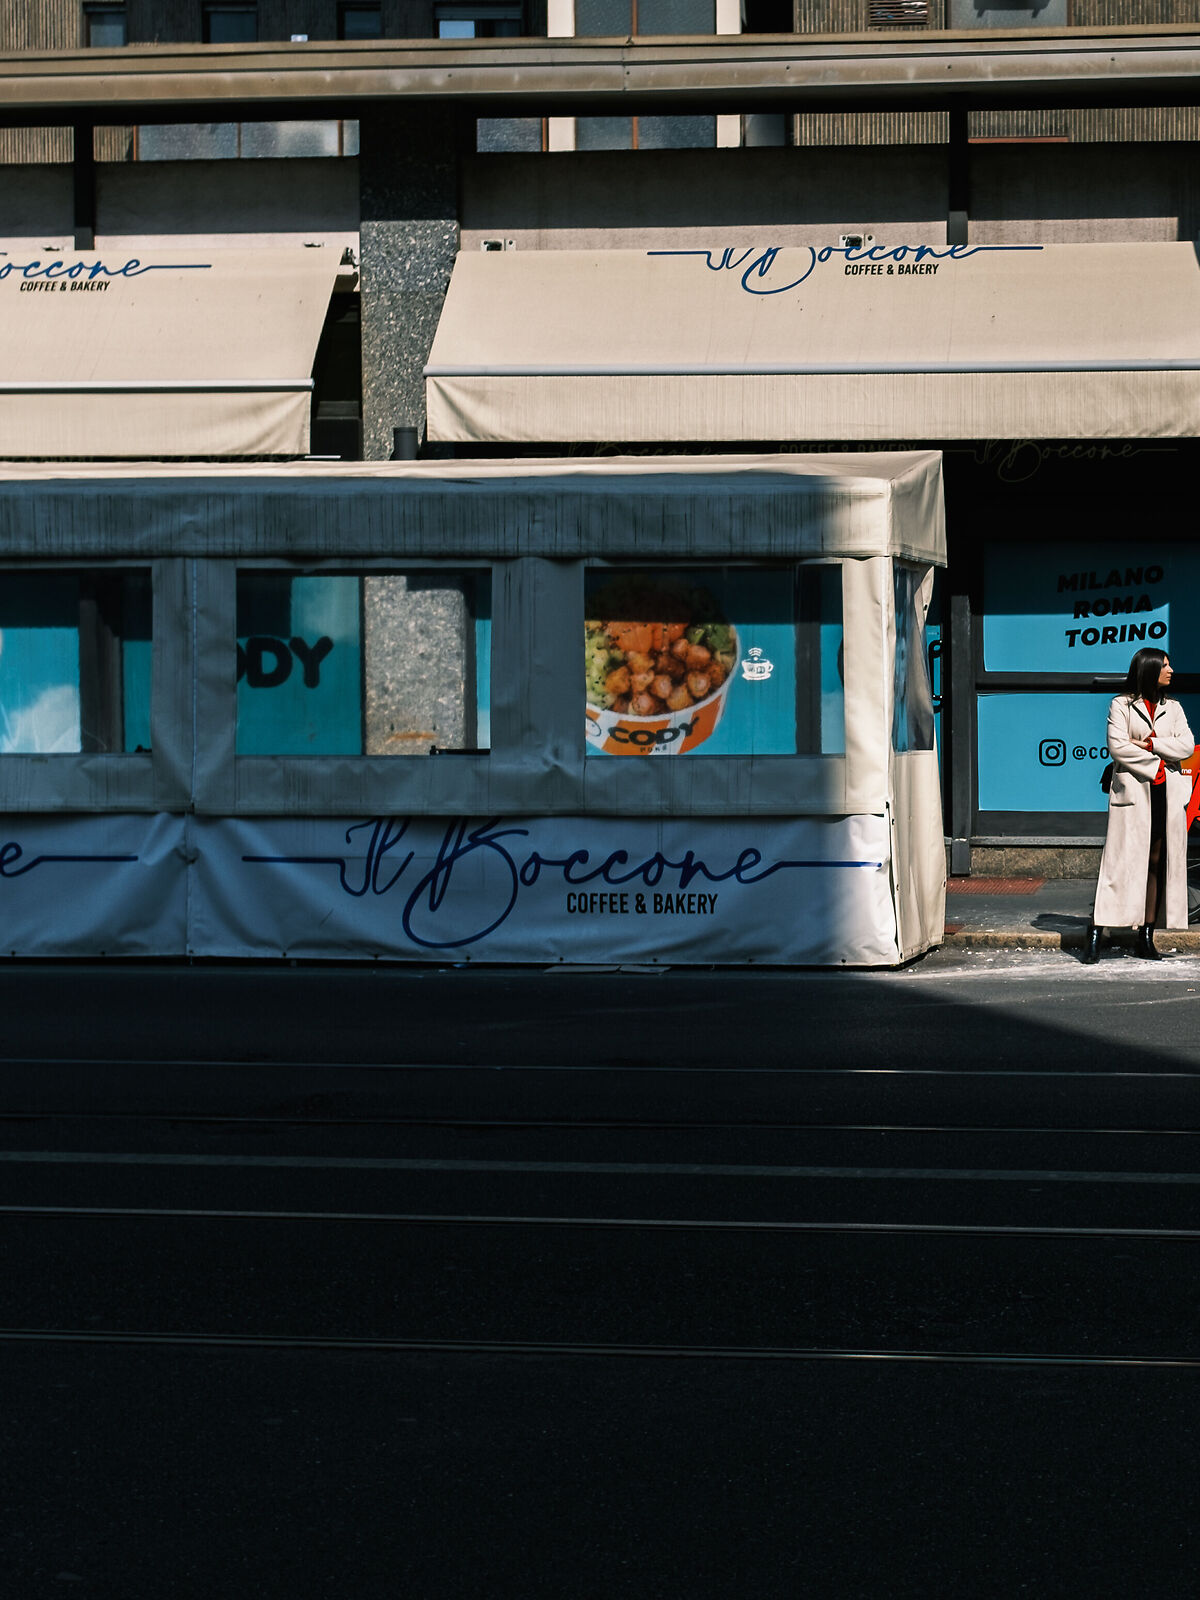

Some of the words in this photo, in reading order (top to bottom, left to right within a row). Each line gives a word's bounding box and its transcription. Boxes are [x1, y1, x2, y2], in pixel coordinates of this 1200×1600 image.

[0, 252, 152, 280] occone
[844, 264, 883, 276] COFFEE
[886, 264, 895, 275] &
[898, 263, 939, 275] BAKERY
[20, 281, 57, 292] COFFEE
[59, 281, 67, 292] &
[70, 281, 111, 292] BAKERY
[1057, 565, 1164, 593] MILANO
[1073, 594, 1153, 620] ROMA
[1065, 620, 1168, 648] TORINO
[237, 636, 334, 689] DY
[608, 716, 700, 746] CODY
[402, 815, 790, 949] Boccone
[566, 892, 631, 915] COFFEE
[634, 892, 649, 914] &
[653, 892, 719, 915] BAKERY
